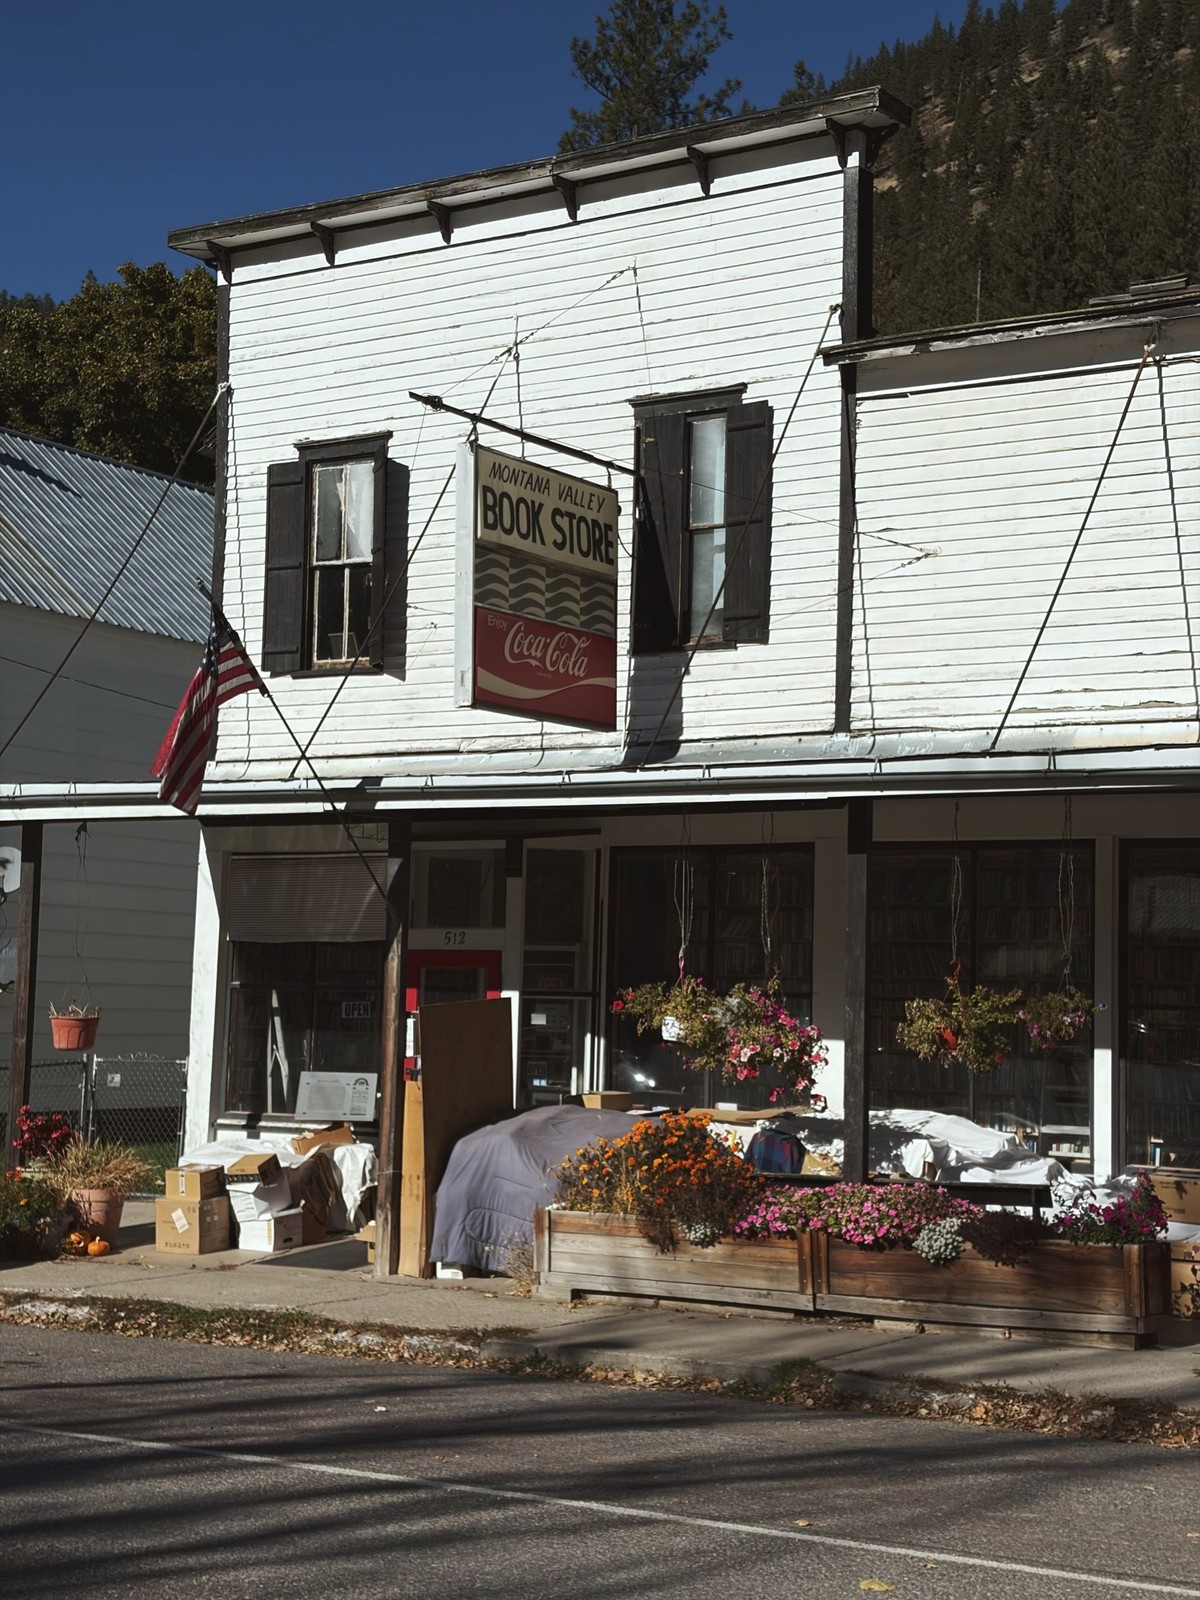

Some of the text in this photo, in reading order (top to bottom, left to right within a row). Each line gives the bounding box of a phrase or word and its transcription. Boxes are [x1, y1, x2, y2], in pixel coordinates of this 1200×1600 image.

[488, 461, 606, 514] MONTANA VALLEY
[482, 484, 615, 566] BOOK STORE
[487, 614, 508, 632] Enjoy
[444, 931, 466, 945] 512
[345, 1003, 369, 1017] OPEN
